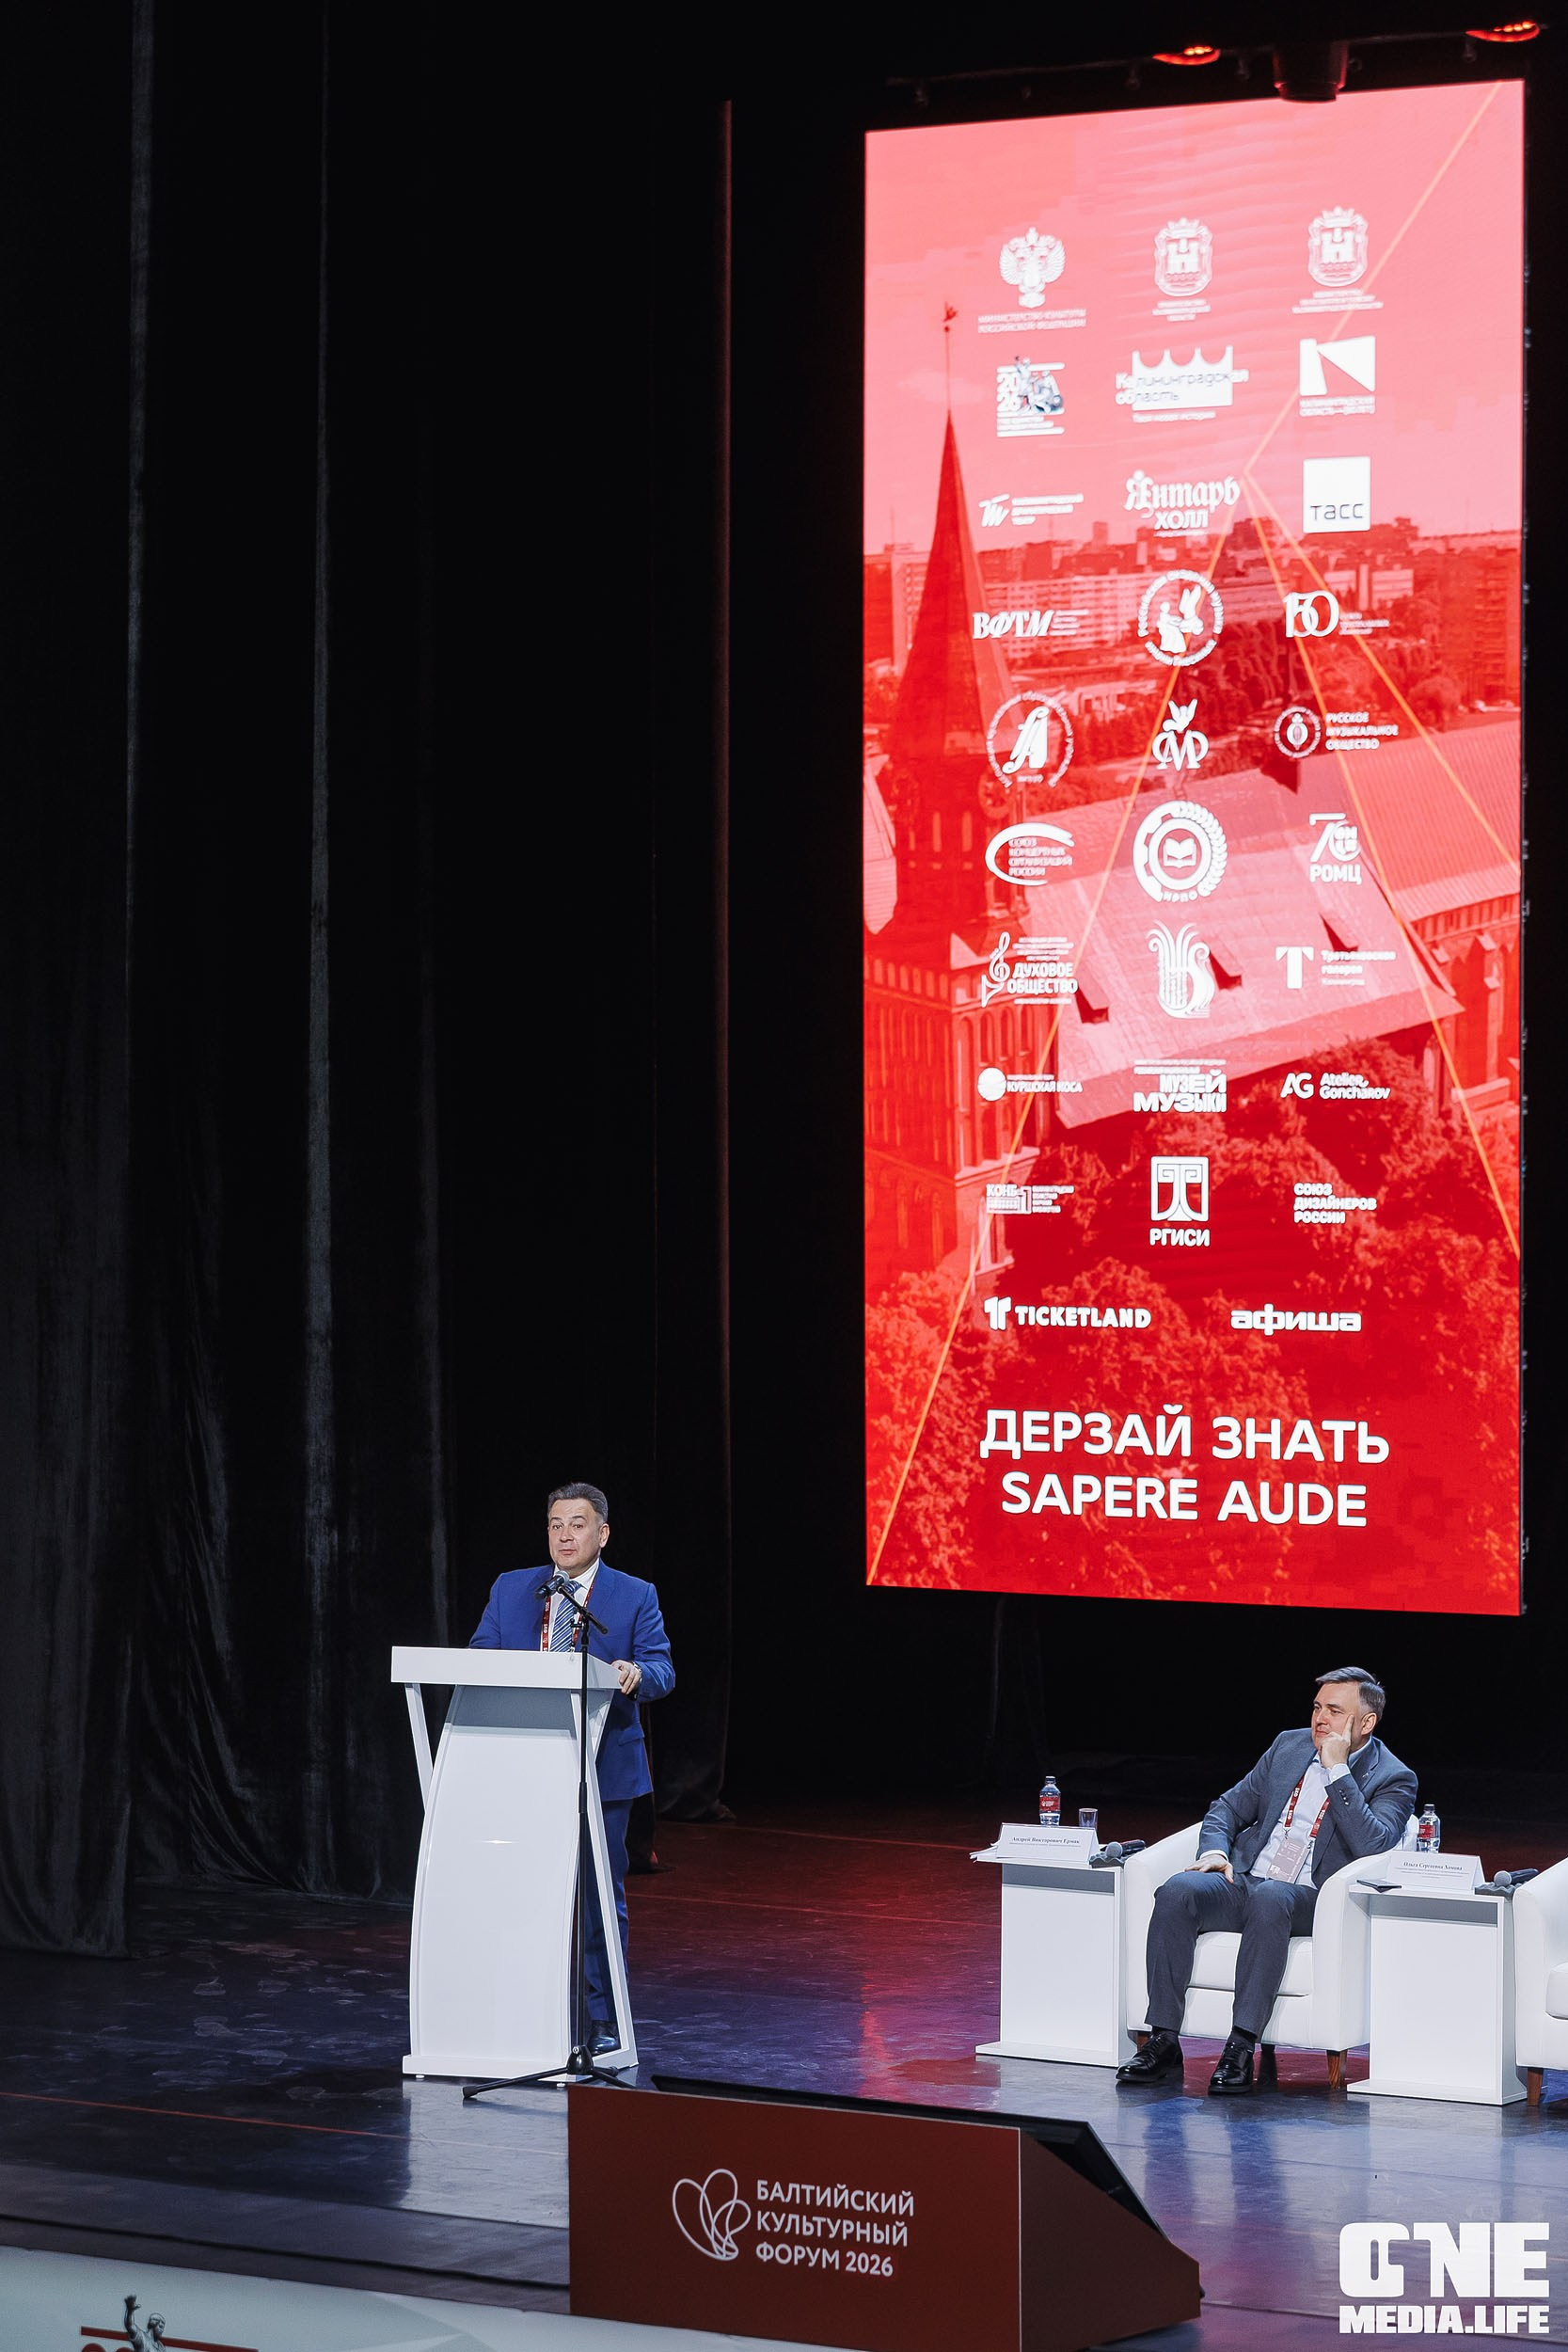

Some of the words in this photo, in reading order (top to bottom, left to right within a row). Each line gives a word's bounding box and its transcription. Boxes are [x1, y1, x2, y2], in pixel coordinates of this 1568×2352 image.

[1310, 864, 1363, 885] РОМЦ
[1013, 962, 1074, 979] ДУХОВОЕ
[1006, 978, 1079, 994] ОБЩЕСТВО
[1160, 1069, 1227, 1092] МУЗЕЙ
[1133, 1092, 1227, 1112] МУЗЫКИ
[1293, 1184, 1333, 1196] СОЮЗ
[1293, 1195, 1377, 1211] ДИЗАЙНЕРОВ
[1293, 1211, 1346, 1223] РОССИИ
[1149, 1229, 1211, 1248] РГИСИ
[1014, 1305, 1152, 1329] TICKETLAND
[1230, 1303, 1362, 1336] афиша
[979, 1404, 1193, 1460] ДЕРЗАЙ
[1212, 1416, 1390, 1464] ЗНАТЬ
[1001, 1470, 1198, 1520] SAPERE
[1217, 1480, 1368, 1527] AUDE
[756, 2180, 914, 2217] БАЛТИЙСКИЙ
[756, 2210, 908, 2247] КУЛЬТУРНЫЙ
[755, 2241, 840, 2270] ФОРУМ
[846, 2250, 894, 2277] 2026
